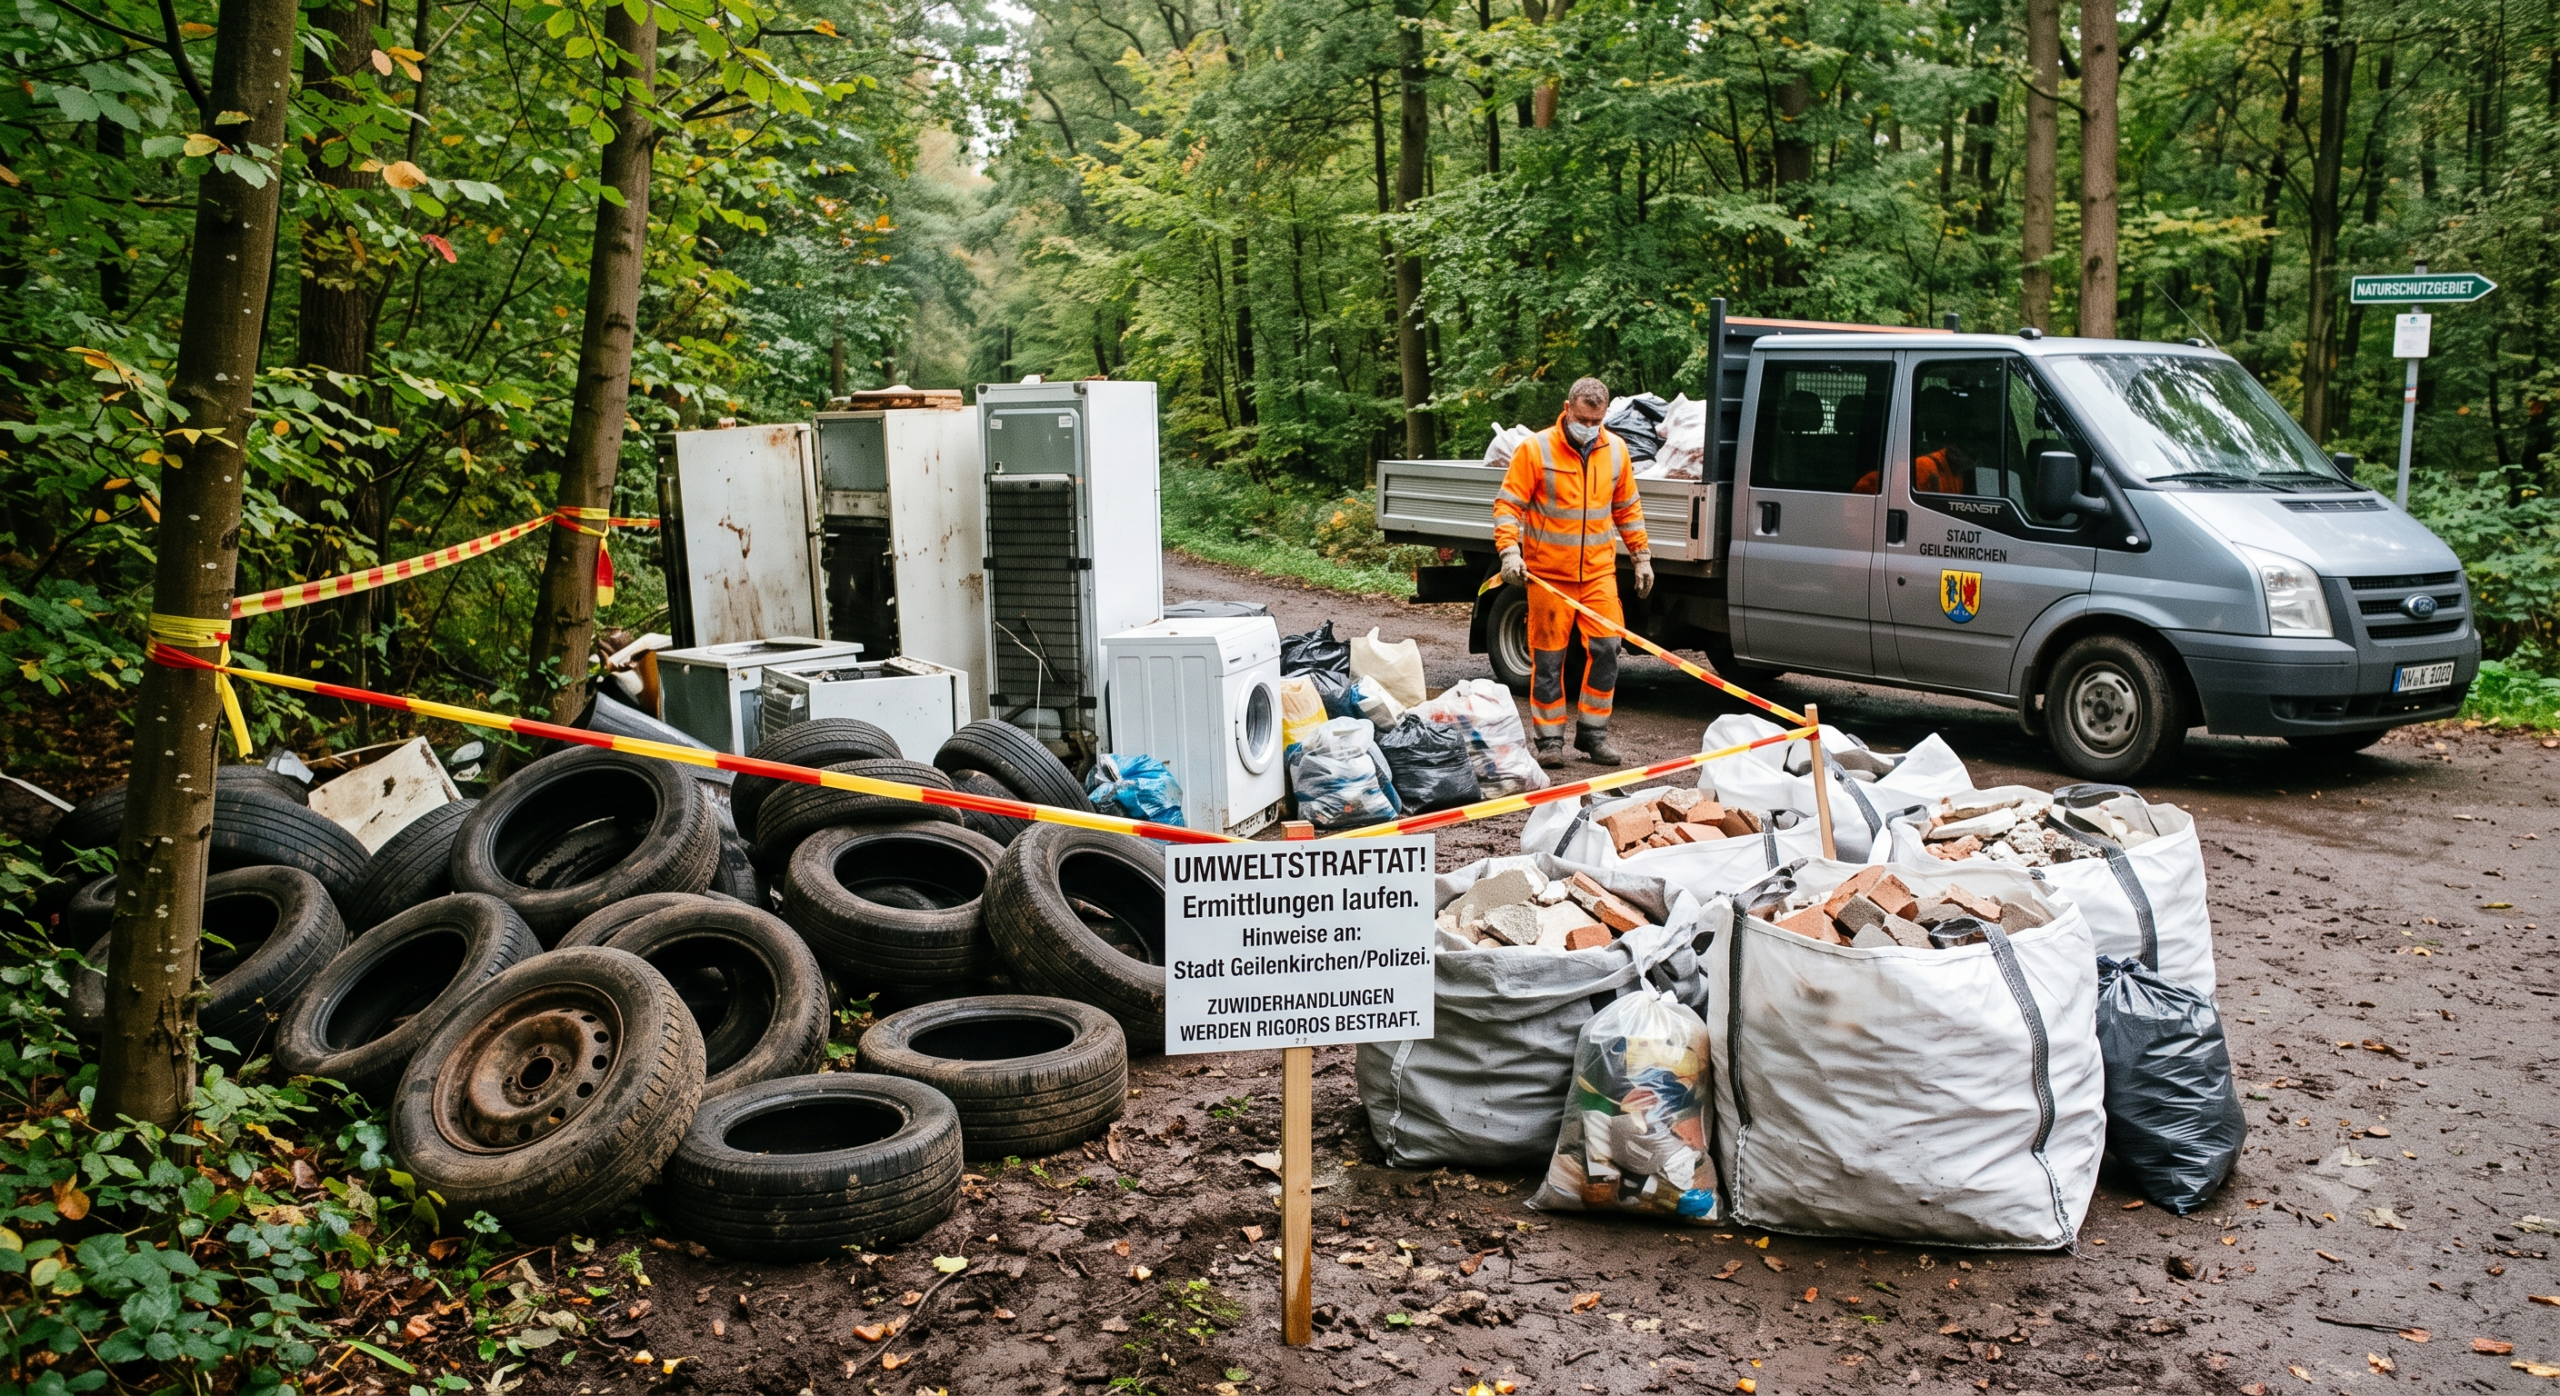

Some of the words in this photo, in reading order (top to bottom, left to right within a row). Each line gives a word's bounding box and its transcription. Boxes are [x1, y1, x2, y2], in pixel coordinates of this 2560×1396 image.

[2357, 281, 2474, 296] NATURSCHUTZGEBIET
[1948, 501, 2001, 514] TRANSIT
[1947, 529, 1981, 543] STADT
[1919, 543, 2007, 562] GEILENKIRCHEN
[1174, 846, 1426, 884] UMWELTSTRAFTAT!
[1183, 892, 1334, 918] Ermittlungen
[1342, 885, 1419, 911] laufen.
[1242, 925, 1328, 947] Hinweise
[1333, 926, 1361, 942] an:
[1174, 958, 1225, 980] Stadt
[1231, 947, 1430, 976] Geilenkirchen/Polizei.
[1207, 987, 1395, 1015] ZUWIDERHANDLUNGEN
[1180, 1021, 1251, 1042] WERDEN
[1256, 1016, 1330, 1037] RIGOROS
[1335, 1010, 1420, 1032] BESTRAFT.
